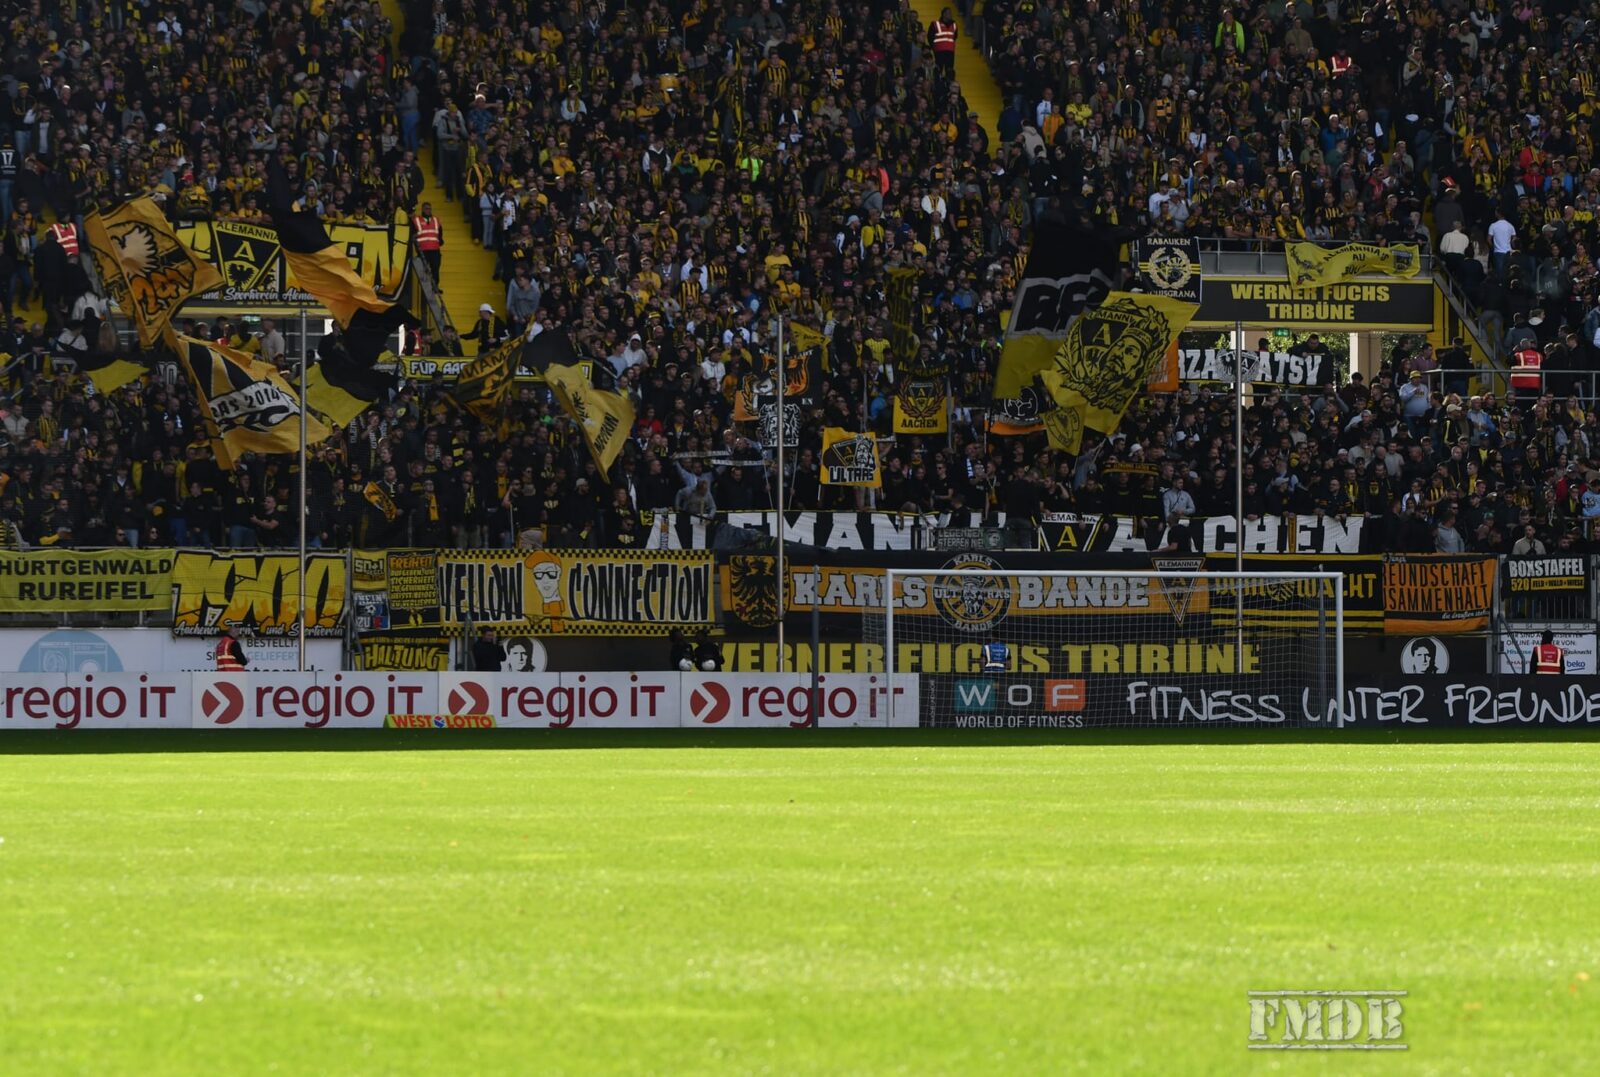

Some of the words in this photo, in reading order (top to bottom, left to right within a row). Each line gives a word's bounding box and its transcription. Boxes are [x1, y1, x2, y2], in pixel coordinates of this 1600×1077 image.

[216, 221, 280, 242] ALEMANNIA
[1146, 237, 1191, 246] RABAUKEN
[1231, 284, 1318, 301] WERNER
[1323, 285, 1391, 302] FUCHS
[1266, 302, 1355, 321] TRIBÜNE
[410, 360, 437, 375] FÜR
[1258, 351, 1323, 386] ATSV
[245, 387, 280, 409] 2014
[901, 418, 938, 428] AACHEN
[829, 466, 874, 483] ULTRAS
[0, 556, 171, 576] HÜRTGENWALD
[1158, 560, 1199, 568] ALEMANNIA
[1508, 558, 1585, 578] BOXSTAFFEL
[19, 580, 153, 601] RUREIFEL
[439, 562, 523, 622] YELLOW
[568, 562, 710, 621] CONNECTION
[792, 572, 928, 609] KARLS
[1018, 576, 1150, 609] BANDE
[1511, 578, 1530, 592] 520
[364, 643, 440, 670] HALTUNG
[1063, 636, 1262, 674] TRIBÜNE
[1566, 660, 1586, 668] beko
[6, 674, 127, 729] regio
[256, 674, 376, 728] regio
[502, 674, 618, 728] regio
[742, 675, 857, 729] regio
[1126, 681, 1286, 723] FITNESS
[391, 715, 432, 728] WEST
[445, 715, 492, 729] LOTTO
[955, 715, 1004, 728] WORLD
[1007, 715, 1025, 728] OF
[1029, 715, 1083, 728] FITNESS
